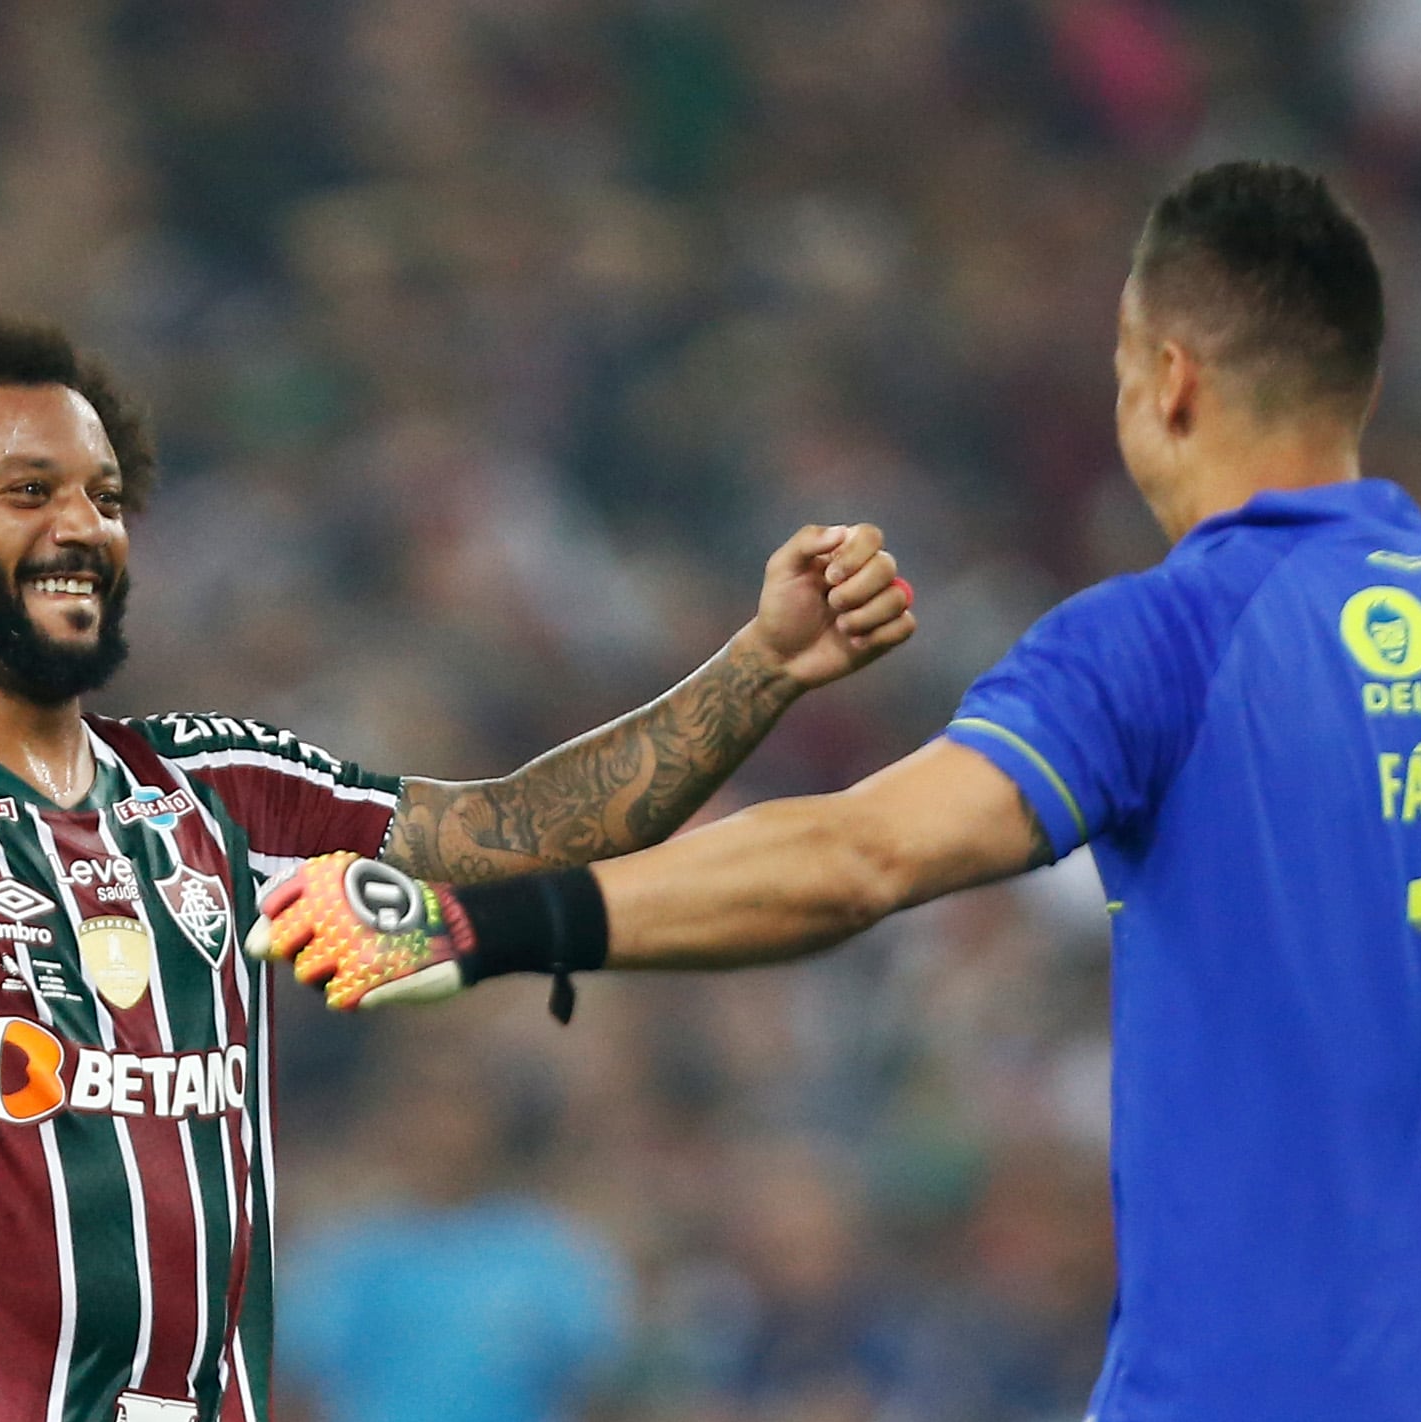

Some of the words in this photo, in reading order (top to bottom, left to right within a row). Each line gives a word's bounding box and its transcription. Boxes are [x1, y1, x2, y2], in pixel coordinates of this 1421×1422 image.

[48, 855, 133, 884] Leve
[96, 882, 140, 902] saúde
[70, 1044, 247, 1117] BETANO
